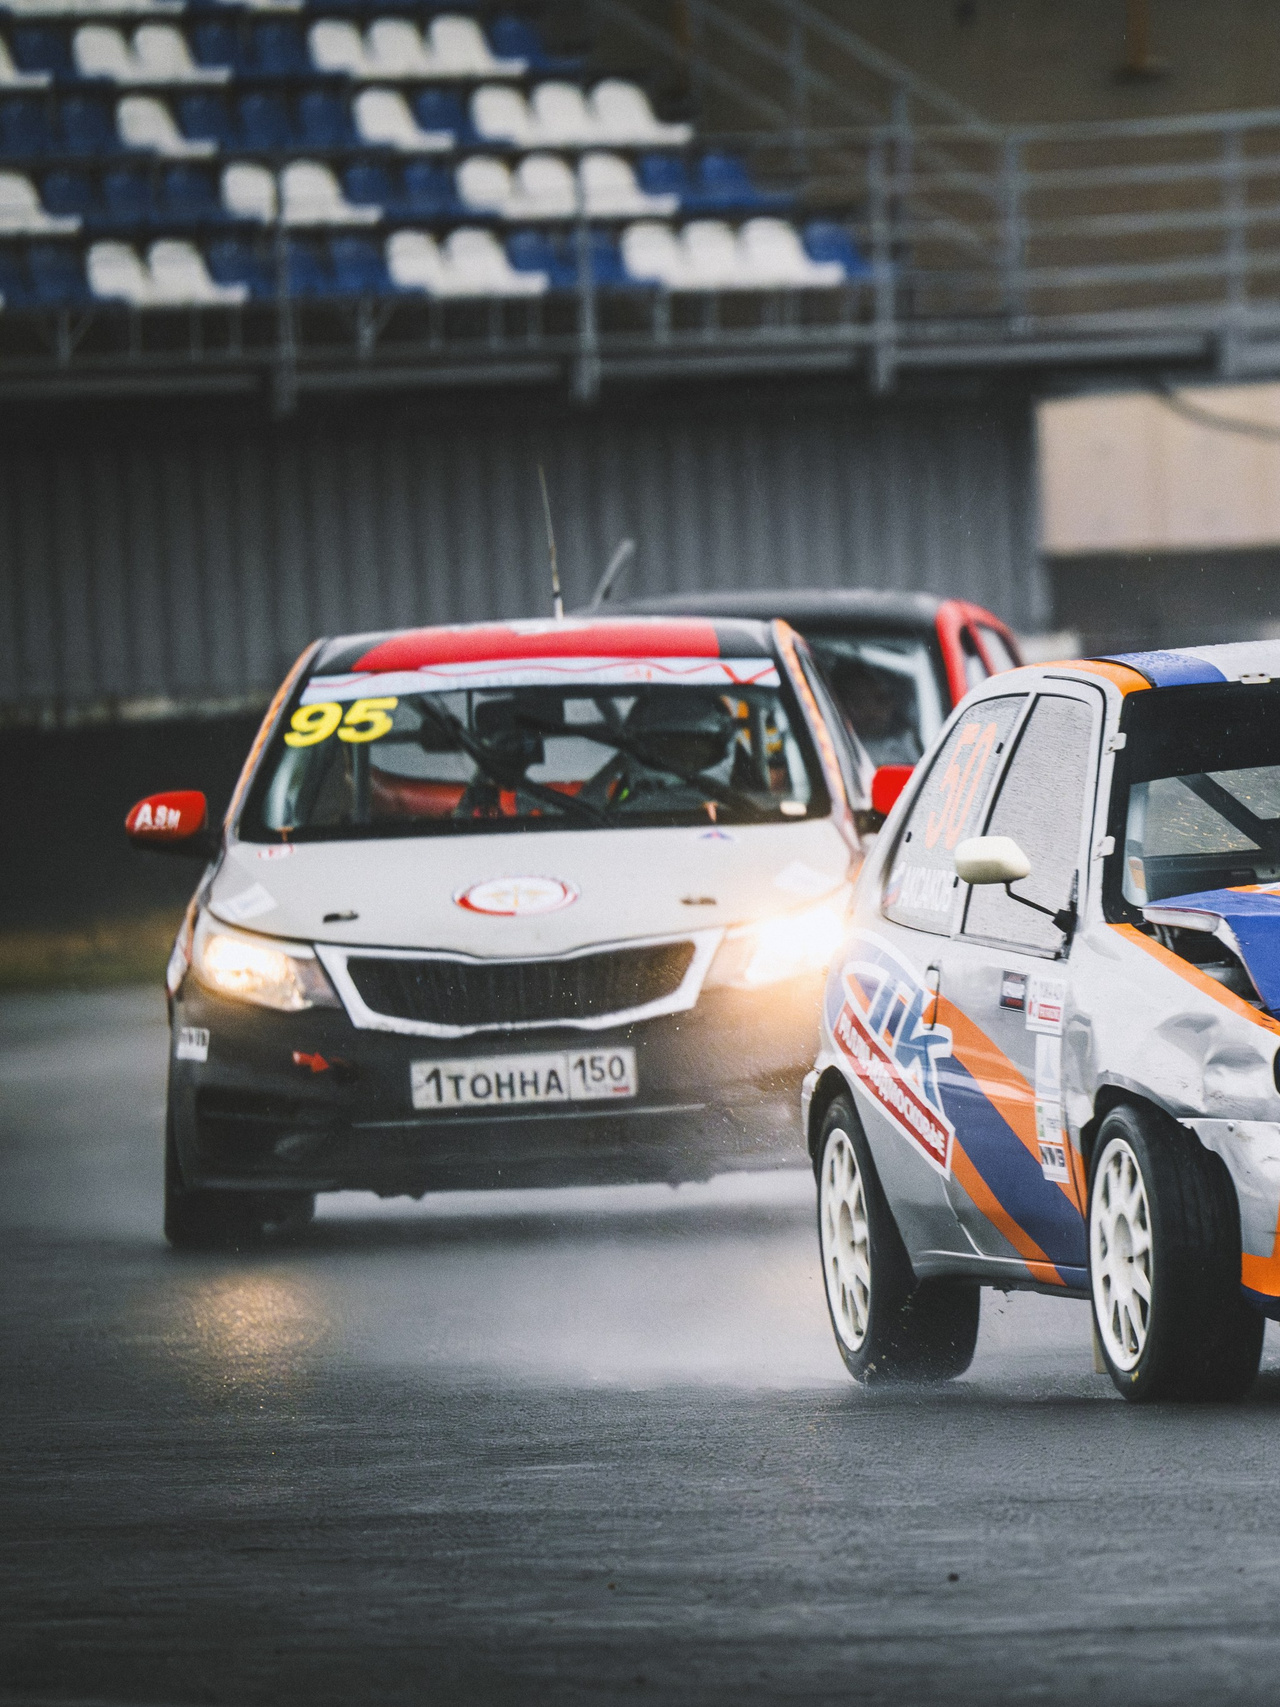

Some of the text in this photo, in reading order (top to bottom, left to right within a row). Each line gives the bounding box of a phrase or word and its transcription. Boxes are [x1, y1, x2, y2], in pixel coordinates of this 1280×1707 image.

[284, 697, 398, 747] 95
[924, 722, 997, 850] 50
[573, 1056, 625, 1085] 150
